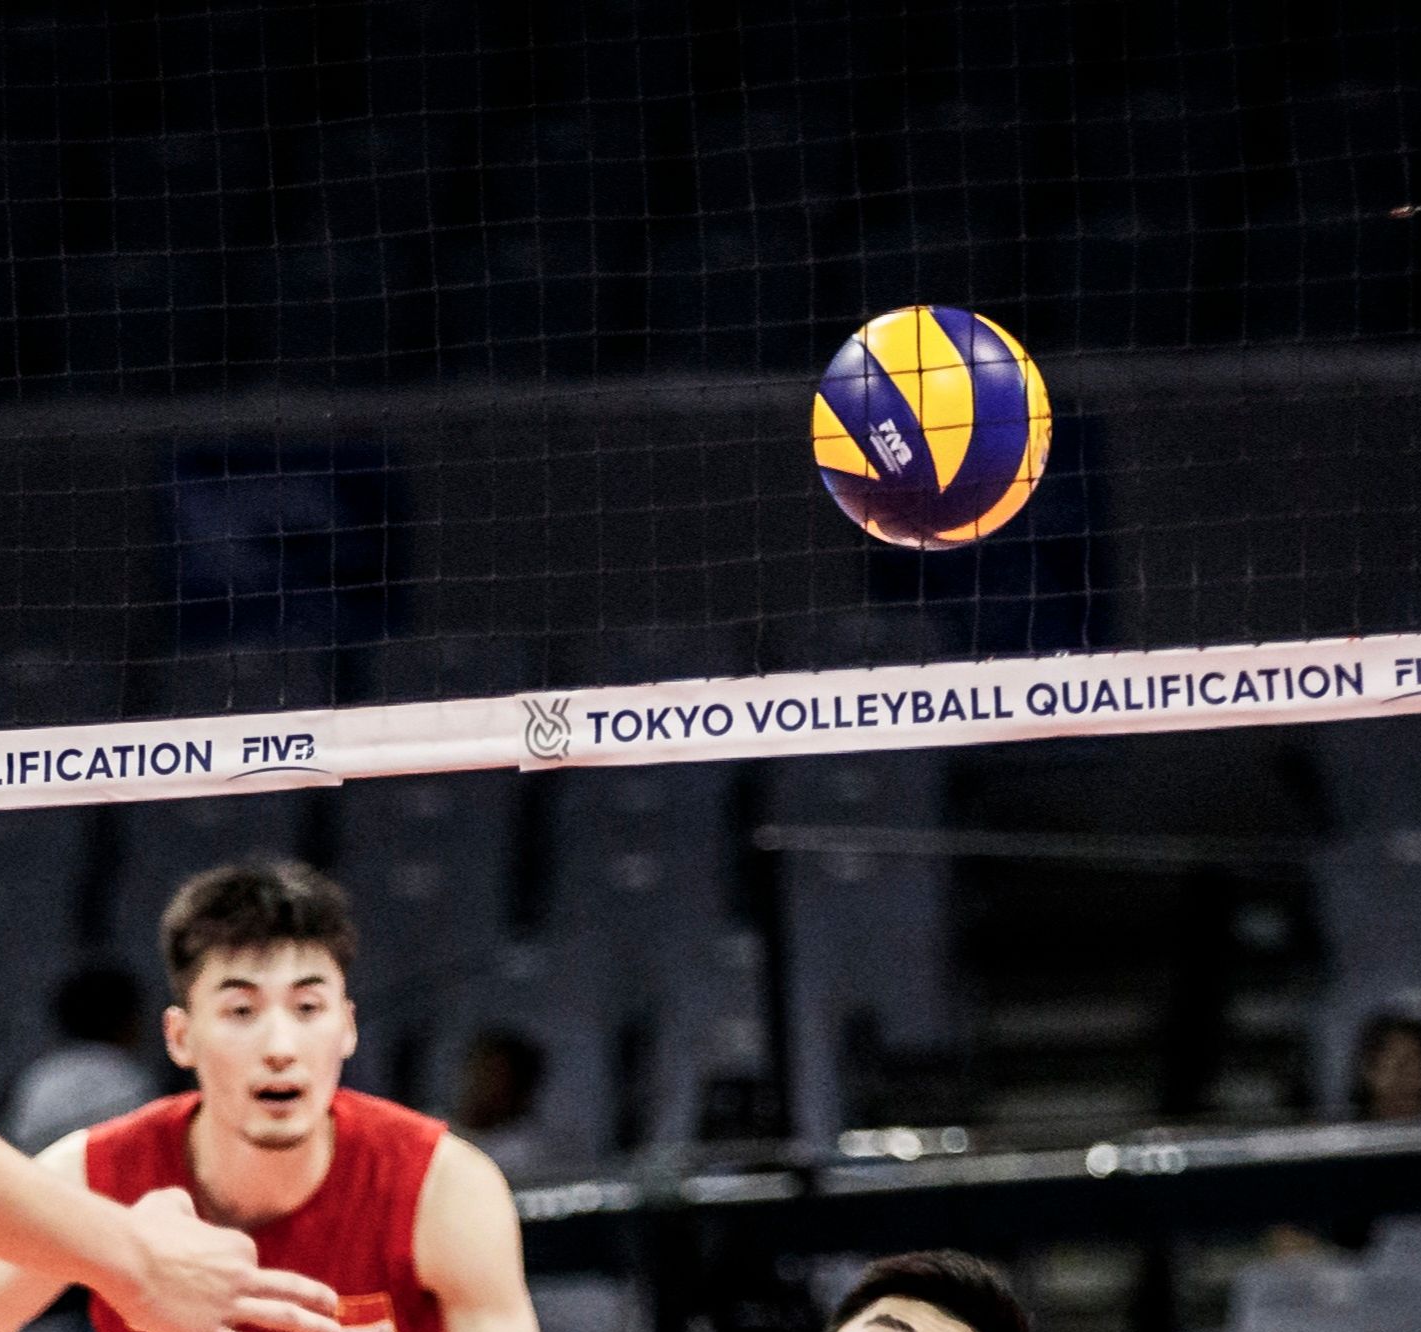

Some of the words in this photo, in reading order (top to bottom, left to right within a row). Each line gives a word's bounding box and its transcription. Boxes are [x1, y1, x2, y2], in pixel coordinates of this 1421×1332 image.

[586, 704, 734, 745] TOKYO
[746, 685, 1014, 734] VOLLEYBALL
[1026, 662, 1364, 718] QUALIFICATION
[242, 733, 316, 764] FIVB
